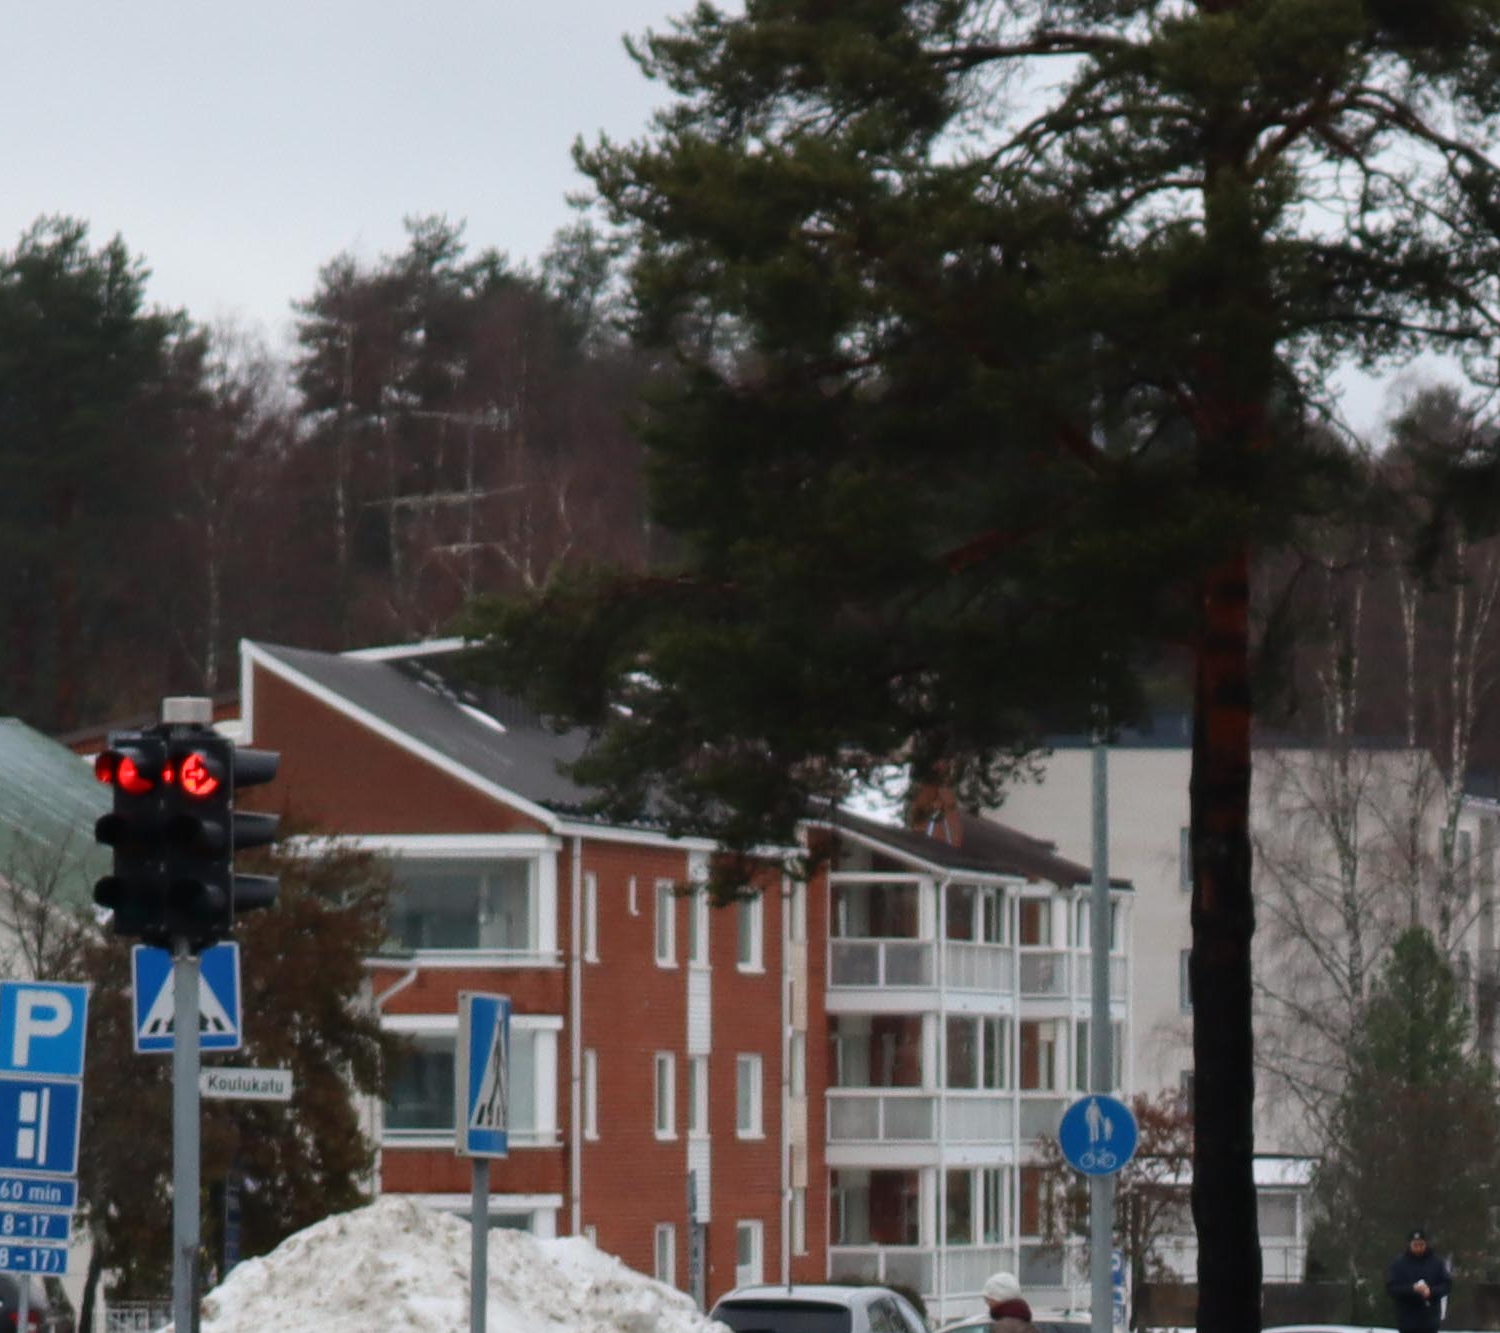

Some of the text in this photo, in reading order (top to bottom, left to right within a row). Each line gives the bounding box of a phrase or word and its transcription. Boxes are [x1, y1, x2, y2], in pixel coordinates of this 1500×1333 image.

[13, 989, 73, 1067] P
[208, 1075, 284, 1093] Koulukatu
[0, 1181, 61, 1202] 60 min
